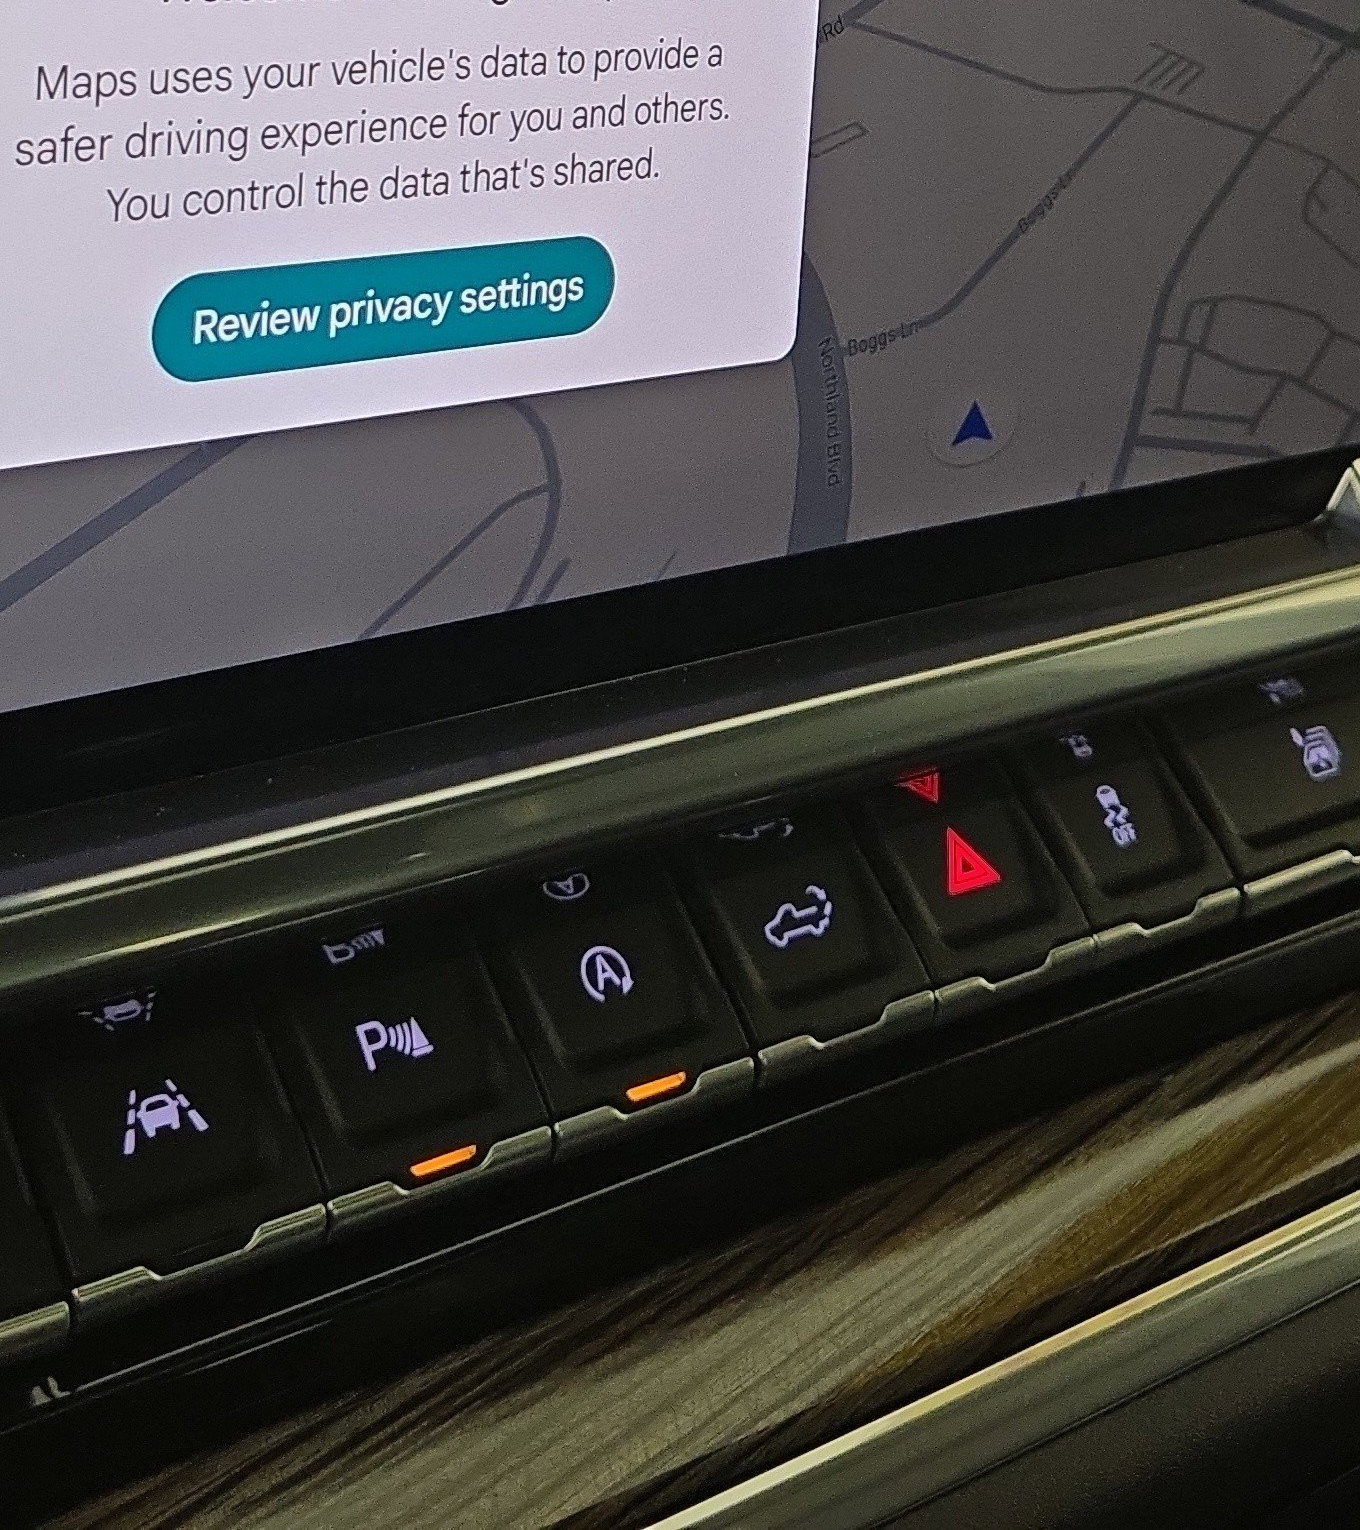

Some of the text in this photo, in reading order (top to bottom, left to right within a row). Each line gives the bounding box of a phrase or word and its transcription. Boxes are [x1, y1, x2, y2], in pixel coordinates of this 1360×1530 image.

[822, 14, 845, 43] Rd
[36, 36, 723, 108] Maps uses your vehicle's data to provide a
[15, 91, 729, 167] safer driving experience for you and others.
[106, 146, 659, 222] You control the data that's shared.
[193, 272, 584, 345] Review privacy settings
[847, 330, 896, 358] Boggs
[818, 336, 841, 488] Northland Blvd
[596, 953, 622, 991] A
[355, 1020, 389, 1072] P
